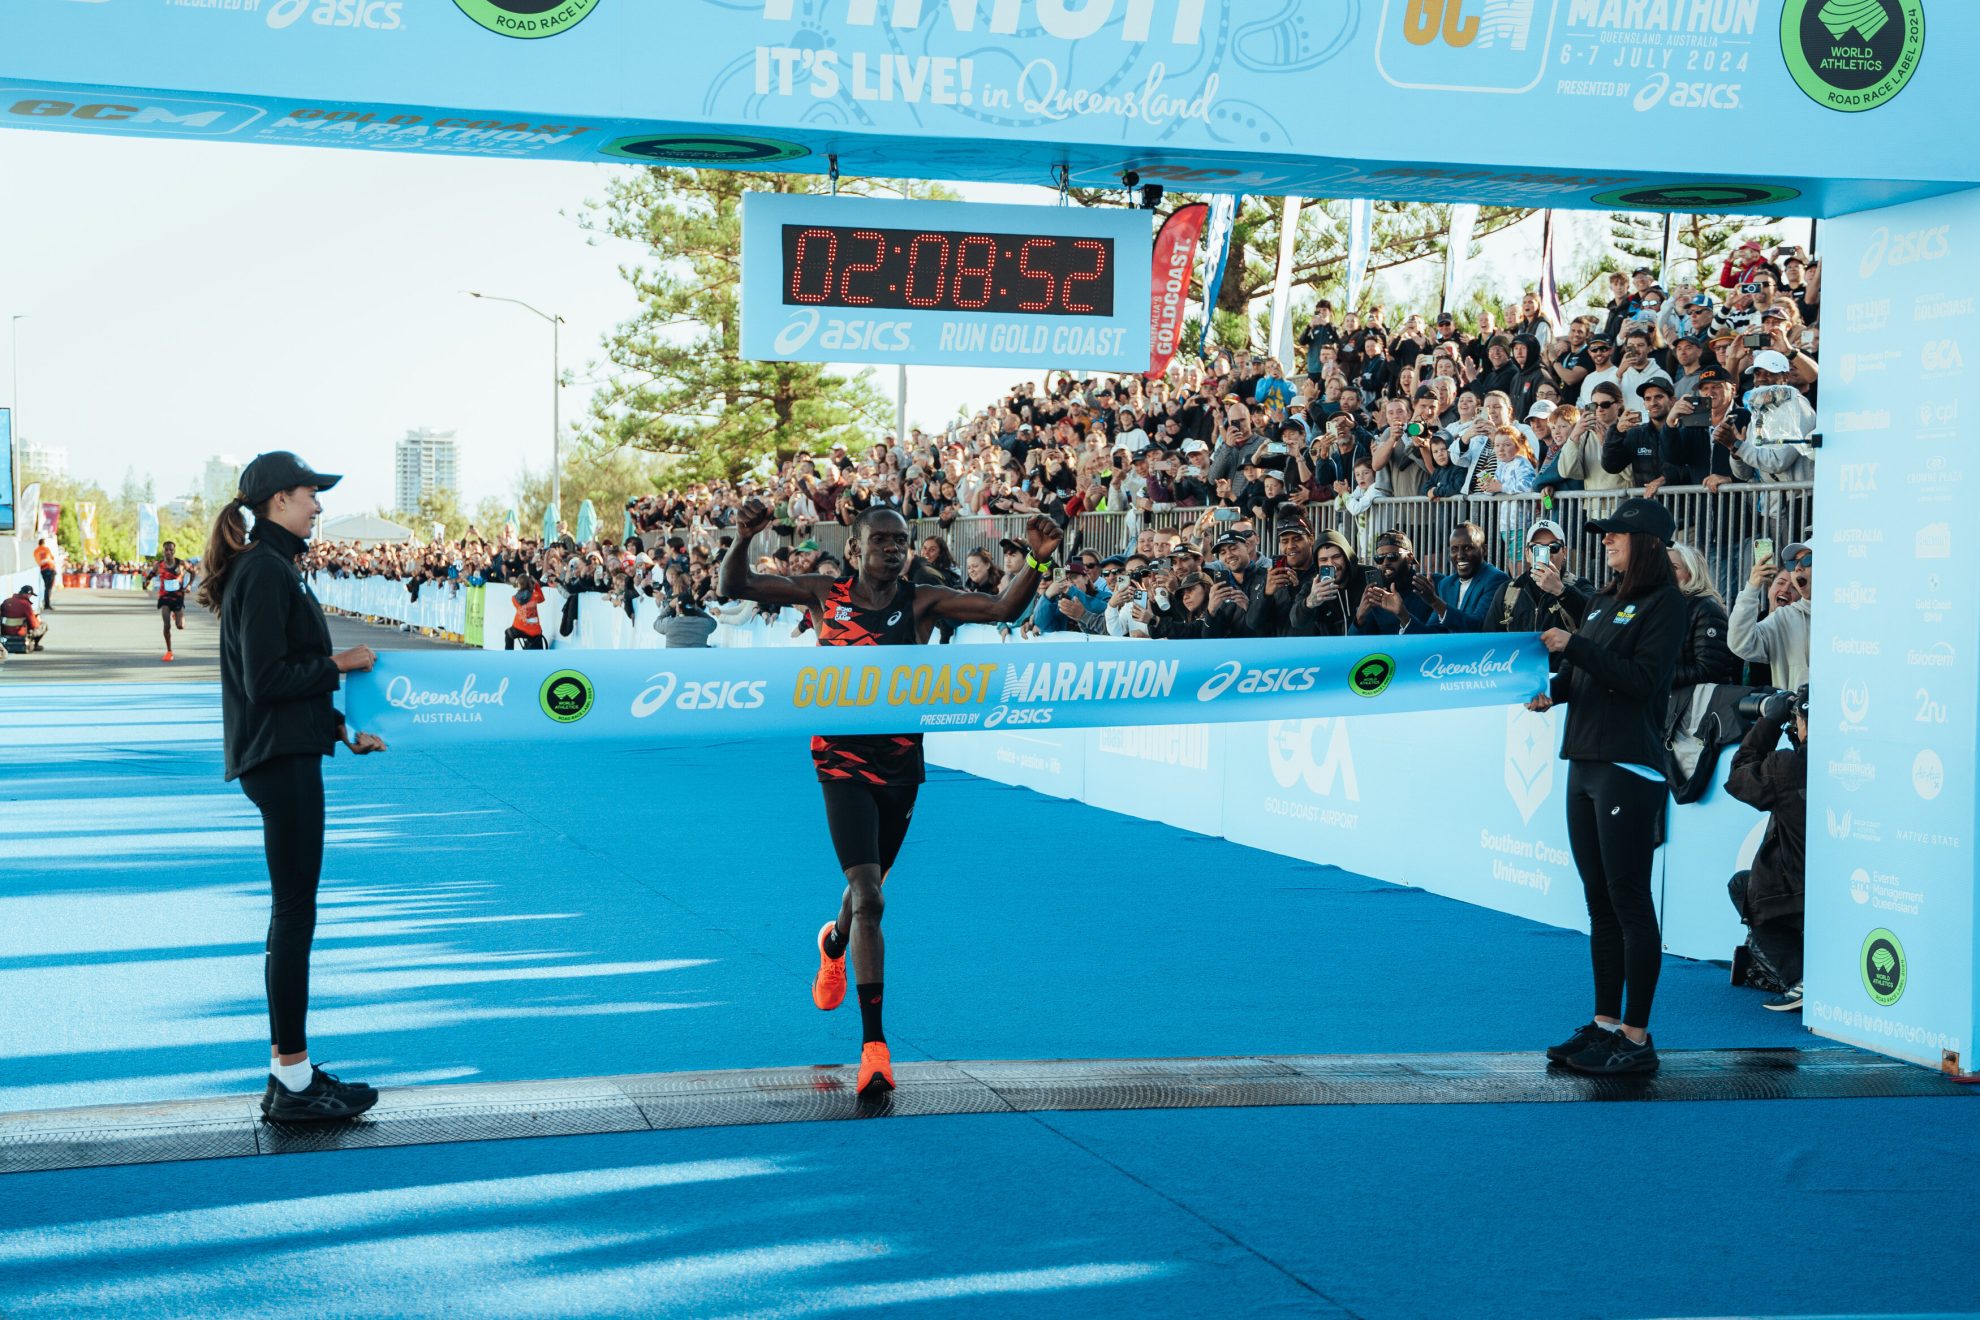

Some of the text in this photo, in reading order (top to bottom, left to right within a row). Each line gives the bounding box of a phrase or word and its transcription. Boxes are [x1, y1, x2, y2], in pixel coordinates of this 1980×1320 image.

[496, 15, 537, 31] ROAD
[540, 6, 576, 29] RACE
[1666, 35, 1718, 47] AUSTRALIA
[1830, 46, 1873, 58] WORLD
[1613, 47, 1673, 69] JULY
[1687, 51, 1749, 72] 2024
[1820, 58, 1882, 71] ATHLETICS
[1827, 8, 1919, 105] ROAD RACE LABEL 2024
[852, 52, 974, 107] LIVE!
[982, 57, 1220, 126] in Queensland
[1557, 79, 1615, 96] PRESENTED
[1616, 82, 1631, 97] BY
[271, 116, 574, 145] MARATHON
[289, 108, 424, 125] GOLD
[433, 117, 593, 137] COAST
[792, 229, 1106, 313] 02:08:52
[939, 322, 987, 352] RUN
[991, 323, 1050, 354] GOLD
[1420, 648, 1520, 679] Queensland
[386, 673, 509, 711] Queensland
[792, 659, 1180, 708] GOLD COAST MARATHON
[1439, 679, 1497, 692] AUSTRALIA
[412, 712, 482, 724] AUSTRALIA
[920, 713, 965, 725] PRESENTED
[967, 712, 980, 725] BY
[1265, 797, 1360, 831] GOLD COAST AIRPORT
[1480, 829, 1570, 867] Southern Cross
[1493, 859, 1551, 896] University
[1873, 870, 1900, 886] Events
[1872, 896, 1920, 916] Queensland
[1873, 885, 1924, 904] Management
